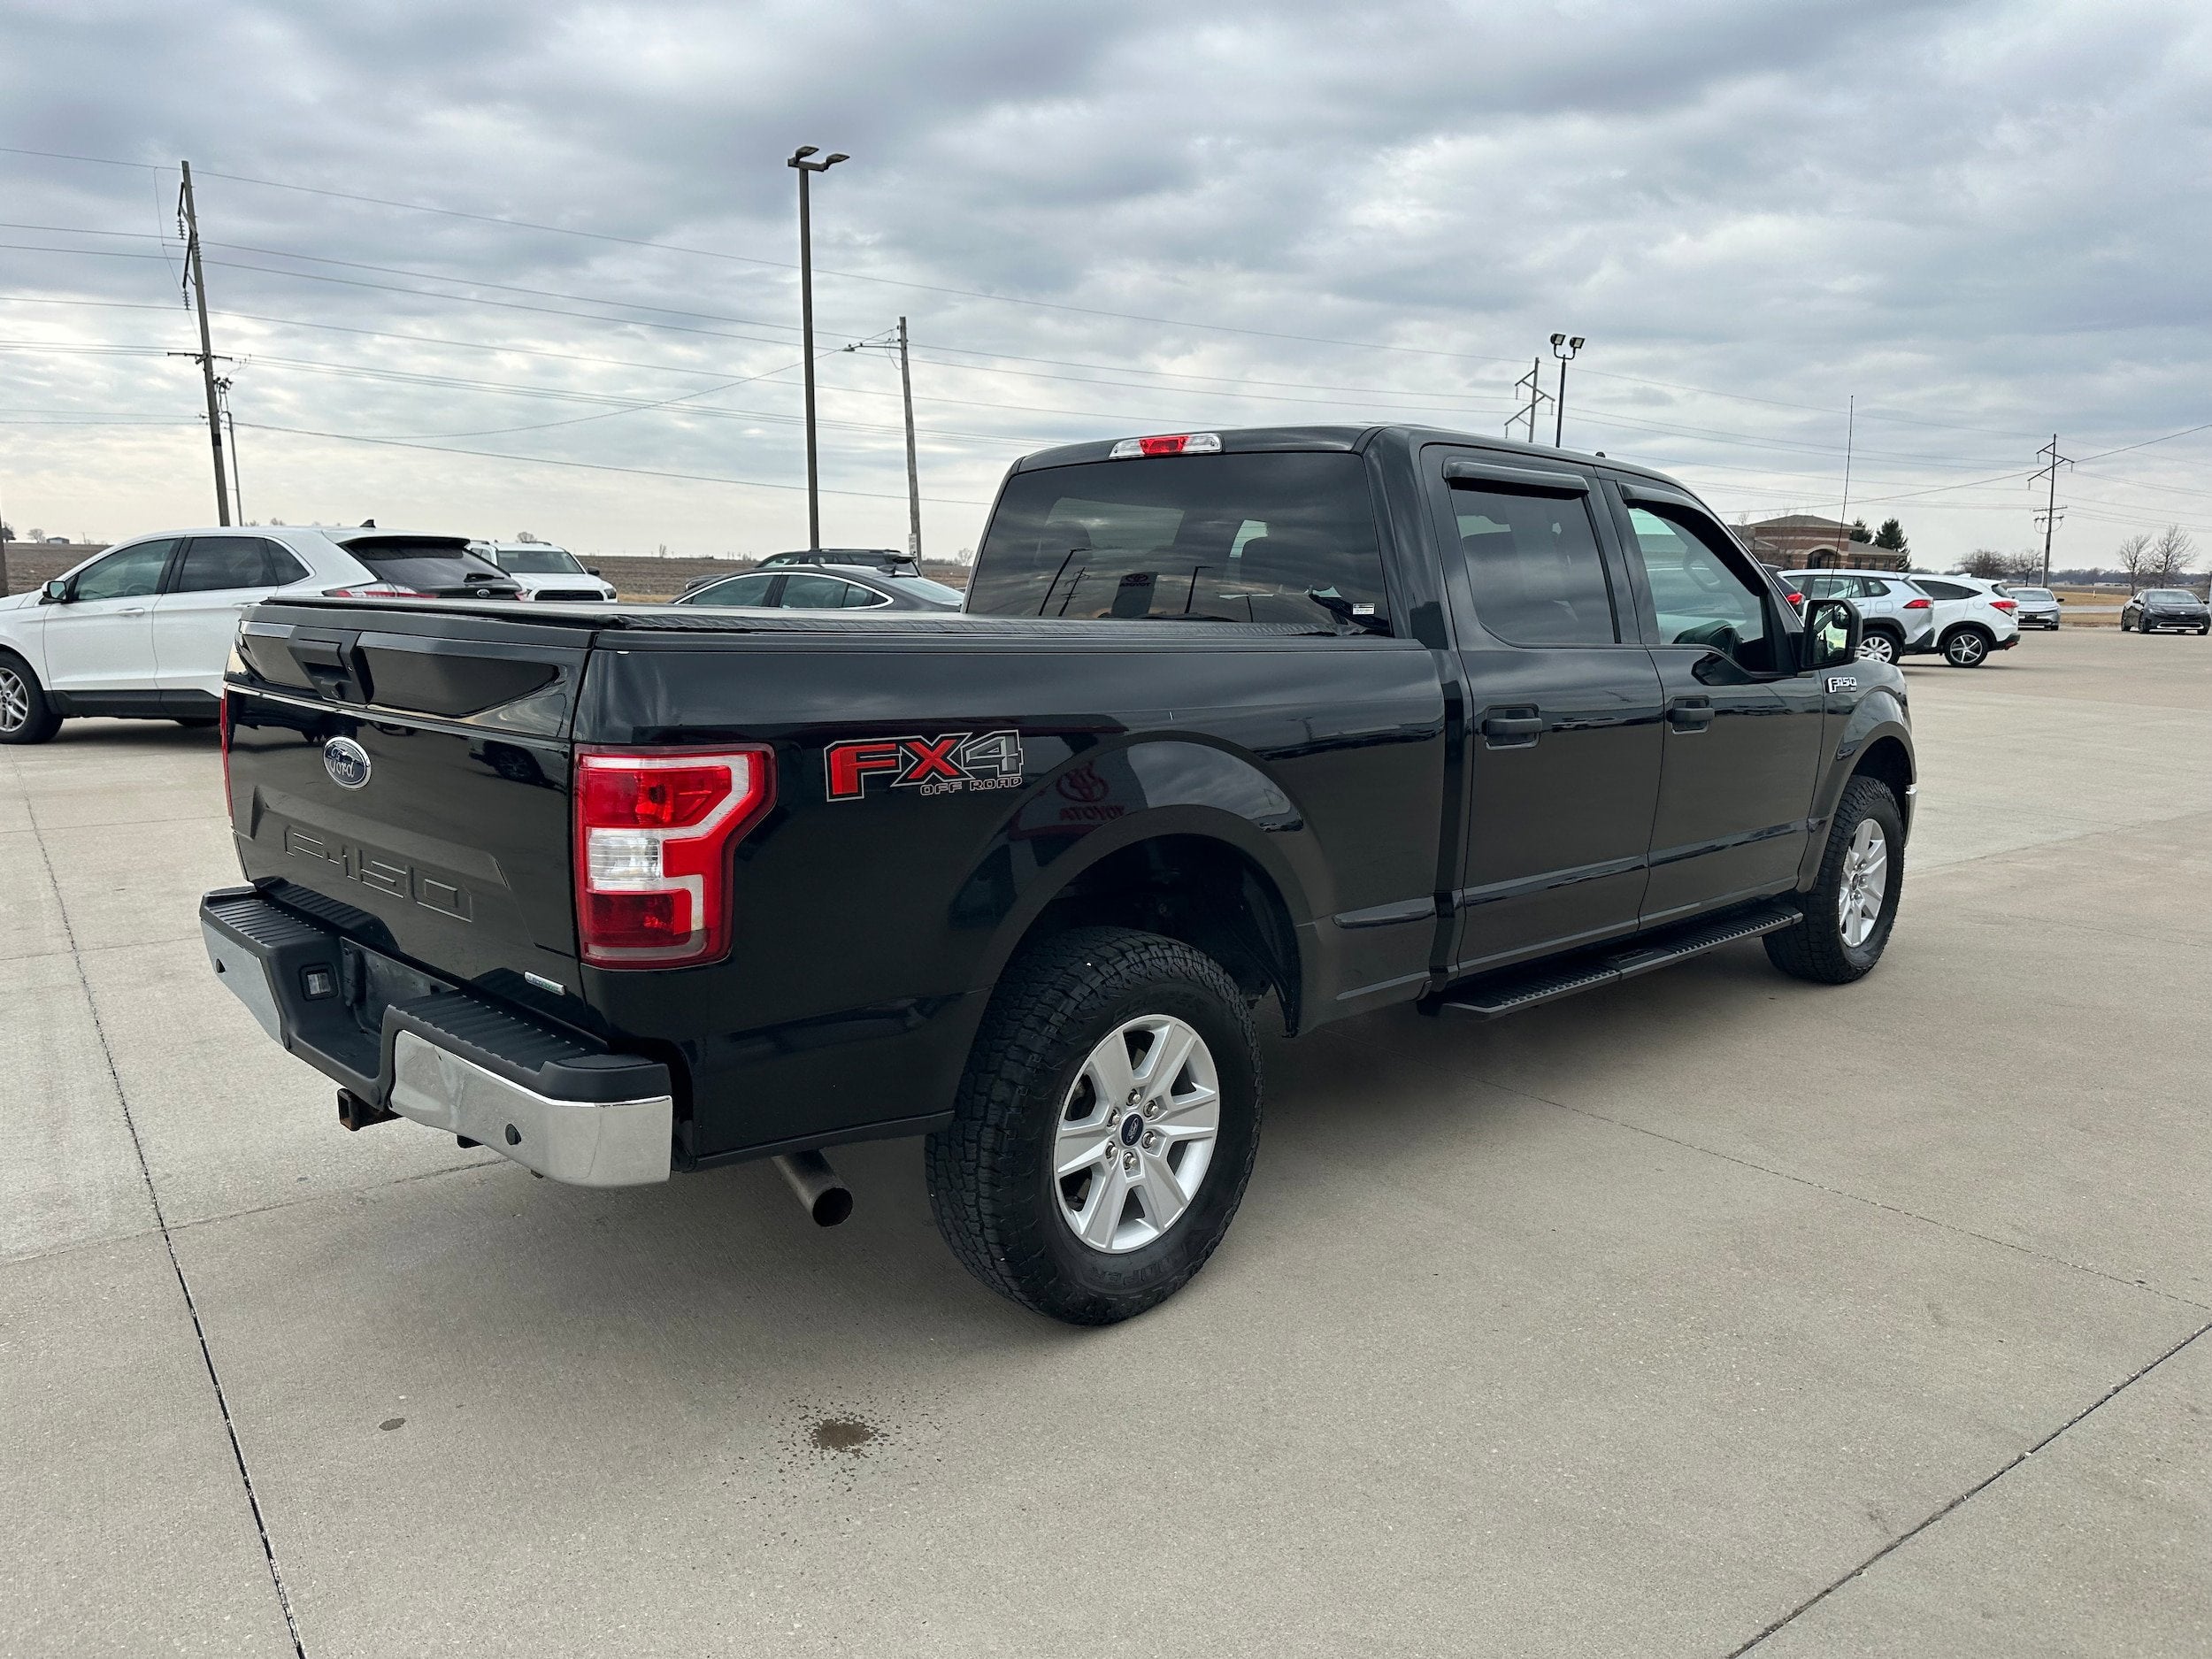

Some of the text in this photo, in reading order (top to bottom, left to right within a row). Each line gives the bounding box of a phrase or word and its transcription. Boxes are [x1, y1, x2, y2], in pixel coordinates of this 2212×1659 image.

[328, 746, 356, 779] Ford
[824, 729, 1024, 802] FX4
[920, 776, 1022, 795] OFF ROAD
[284, 826, 473, 923] F-150
